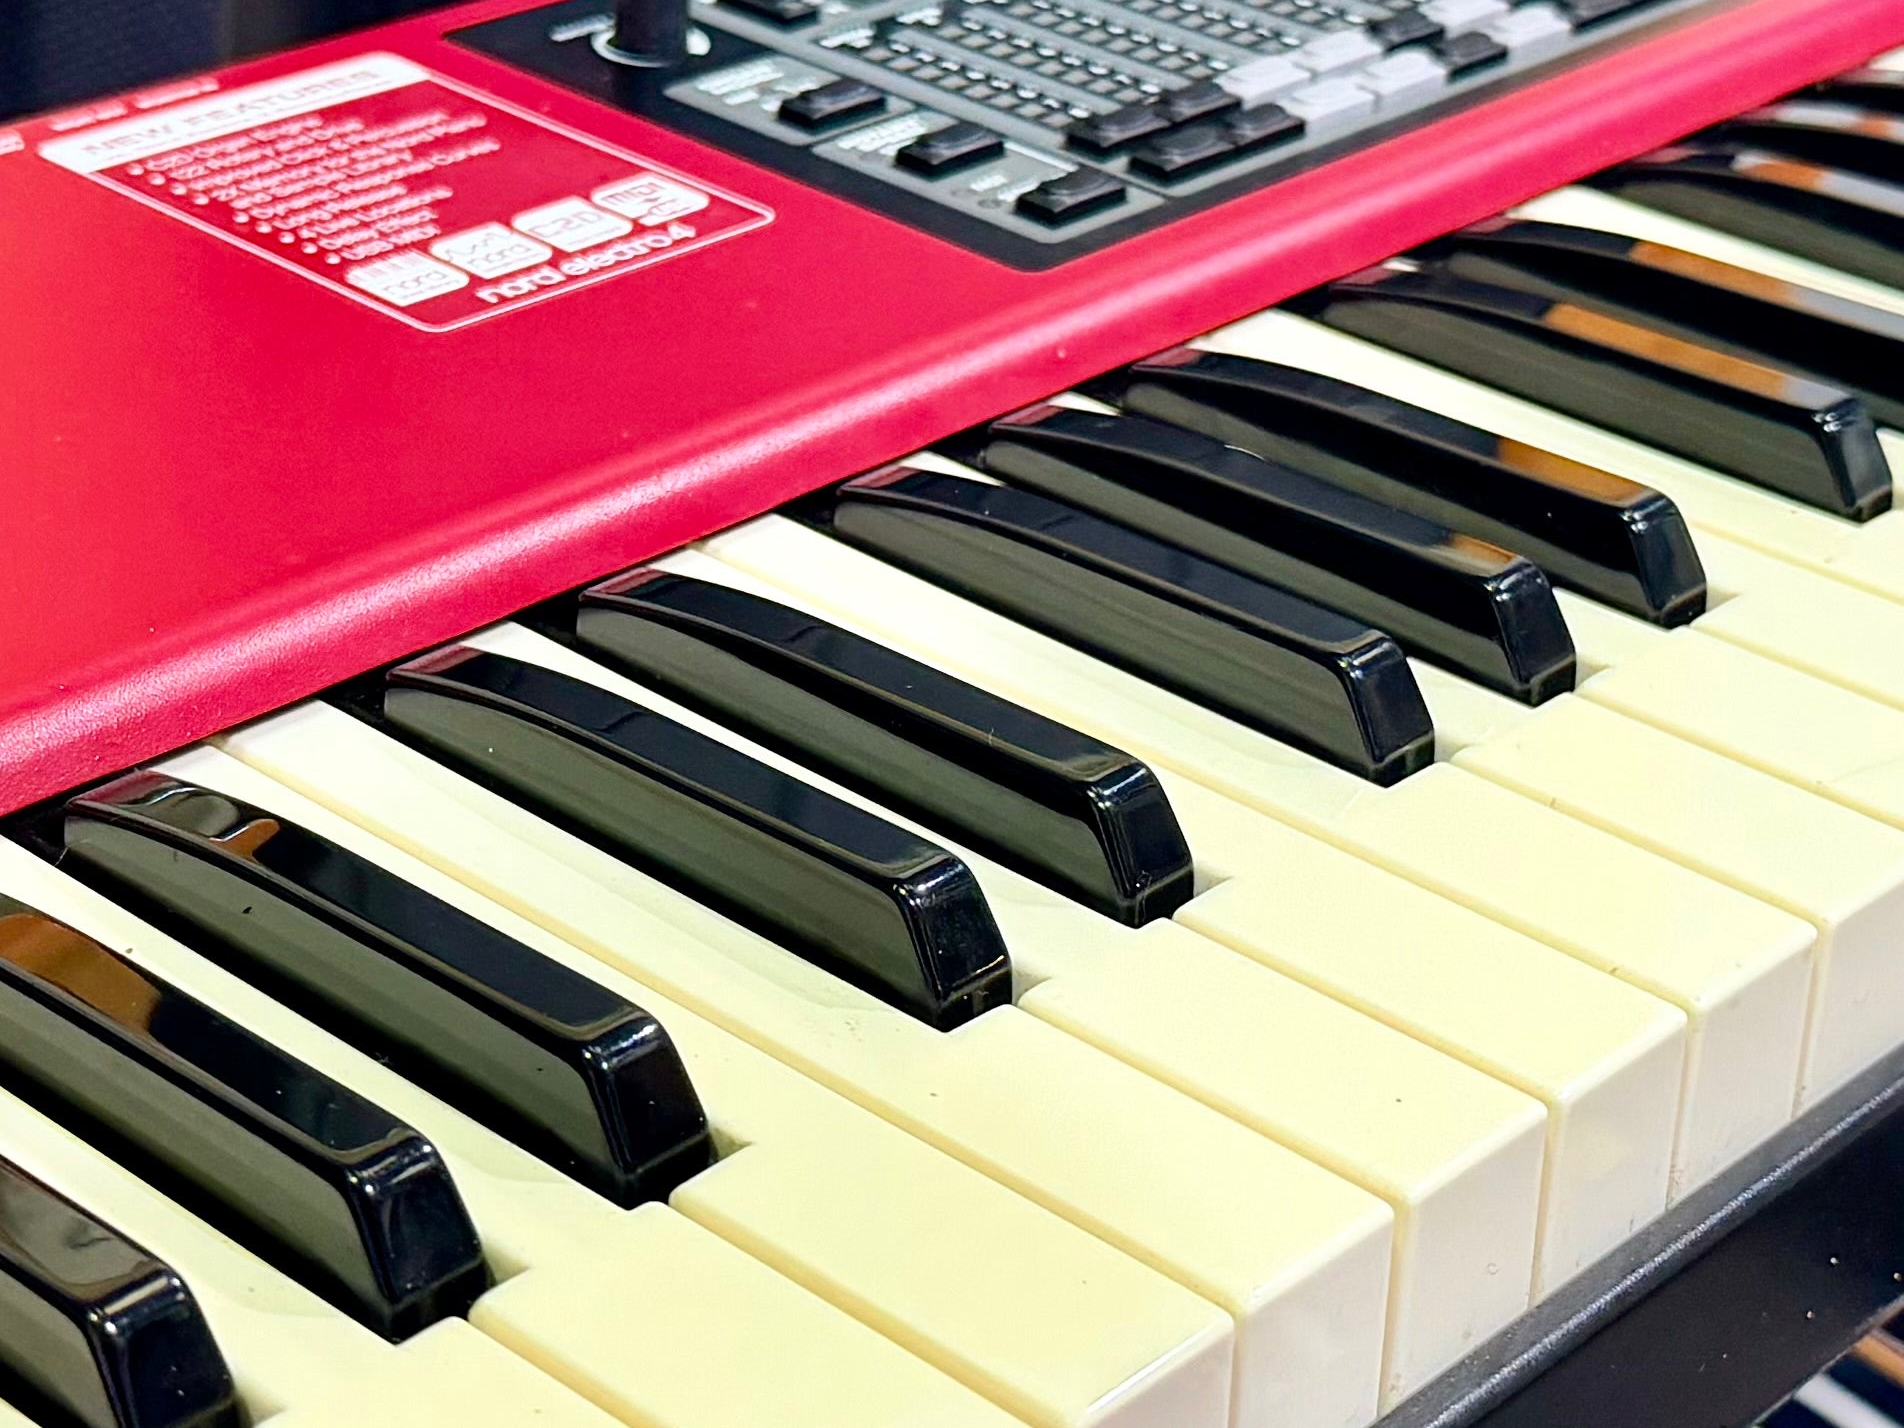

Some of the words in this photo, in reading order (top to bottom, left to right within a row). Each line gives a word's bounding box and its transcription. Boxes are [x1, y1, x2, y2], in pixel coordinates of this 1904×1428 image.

[79, 123, 180, 155] NEW
[180, 68, 381, 126] FEATURES
[525, 208, 608, 239] C2D
[463, 242, 534, 268] nord
[379, 269, 449, 295] nord
[471, 266, 568, 304] nord
